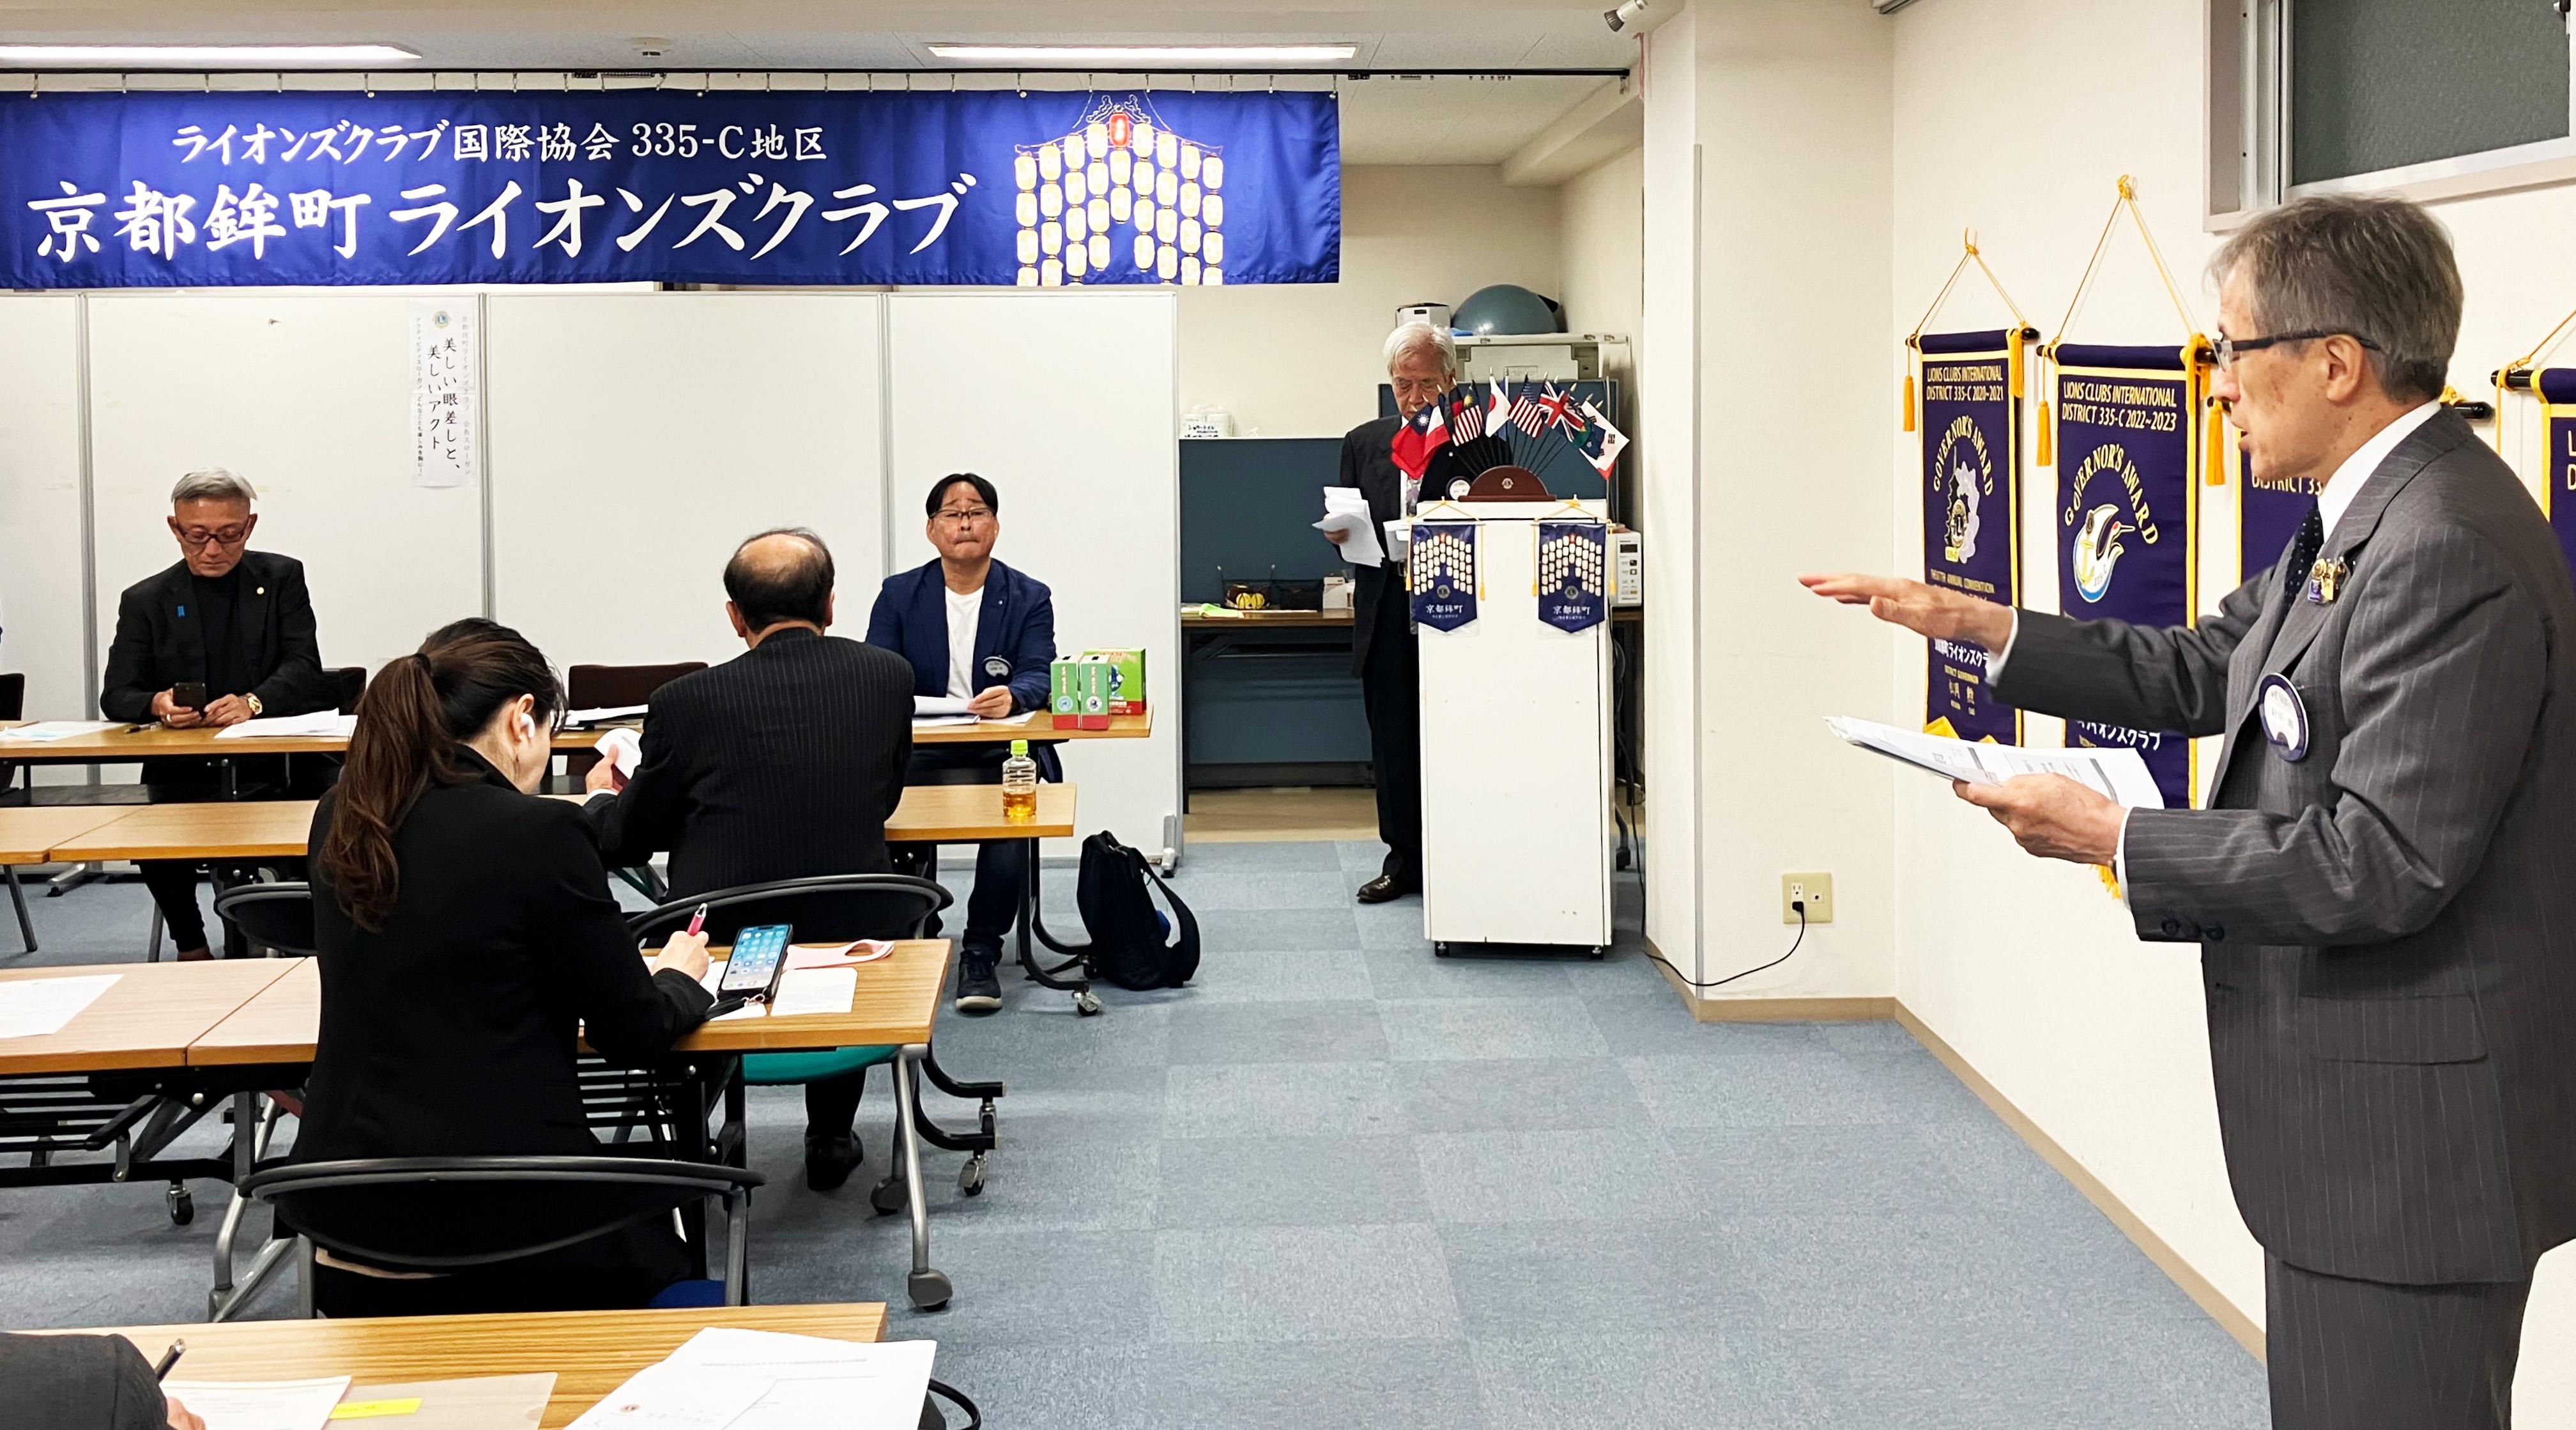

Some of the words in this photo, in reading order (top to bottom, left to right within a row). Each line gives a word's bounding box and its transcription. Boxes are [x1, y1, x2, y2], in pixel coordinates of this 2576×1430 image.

[172, 119, 620, 165] ライオンズクラブ国際協会
[27, 180, 372, 263] 京都鉾町
[388, 173, 976, 261] ライオンズクラブ
[427, 345, 441, 449] 美しいアクト
[443, 337, 460, 468] 美しい眼差しと、
[1926, 385, 1953, 401] DISTRICT
[1954, 385, 1972, 401] 335-C
[1927, 367, 1943, 382] LIONS
[1943, 367, 1961, 382] CLUBS
[1961, 365, 2004, 382] INTERNATIONAL
[2063, 381, 2085, 399] LIONS
[2085, 383, 2112, 403] CLUBS
[2112, 385, 2177, 408] INTERNATIONAL
[2062, 403, 2097, 424] DISTRICT
[2098, 406, 2126, 427] 335-C
[1972, 426, 1993, 496] AWARD
[2065, 443, 2124, 527] GOVERNOR'S
[2121, 460, 2159, 544] AWARD
